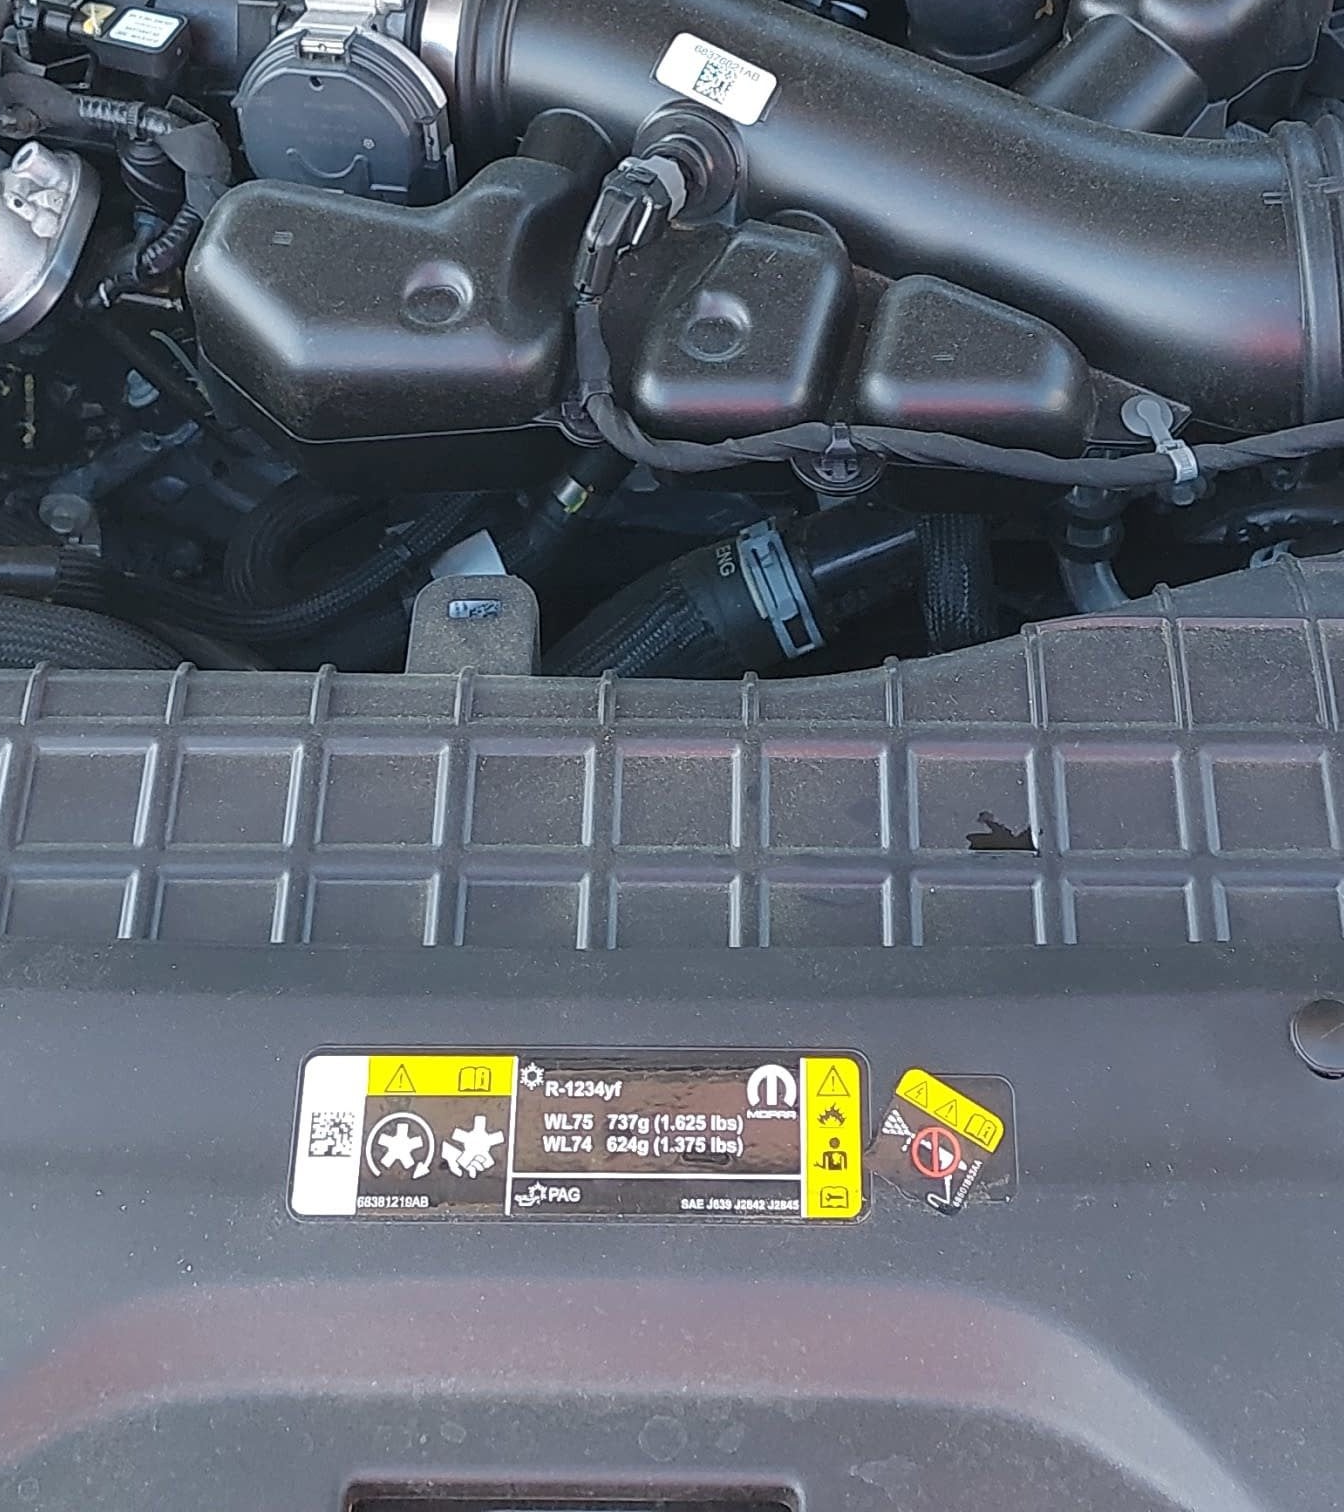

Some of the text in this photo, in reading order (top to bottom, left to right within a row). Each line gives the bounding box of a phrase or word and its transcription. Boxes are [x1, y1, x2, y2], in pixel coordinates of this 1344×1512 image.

[545, 1080, 622, 1101] R-1234yf
[544, 1114, 744, 1133] WL75 737g (1.625 lbs)
[746, 1110, 797, 1120] MOPAR
[543, 1136, 744, 1157] WL74 624g (1.375 lbs)
[549, 1187, 581, 1202] PAG
[681, 1198, 704, 1210] SAE
